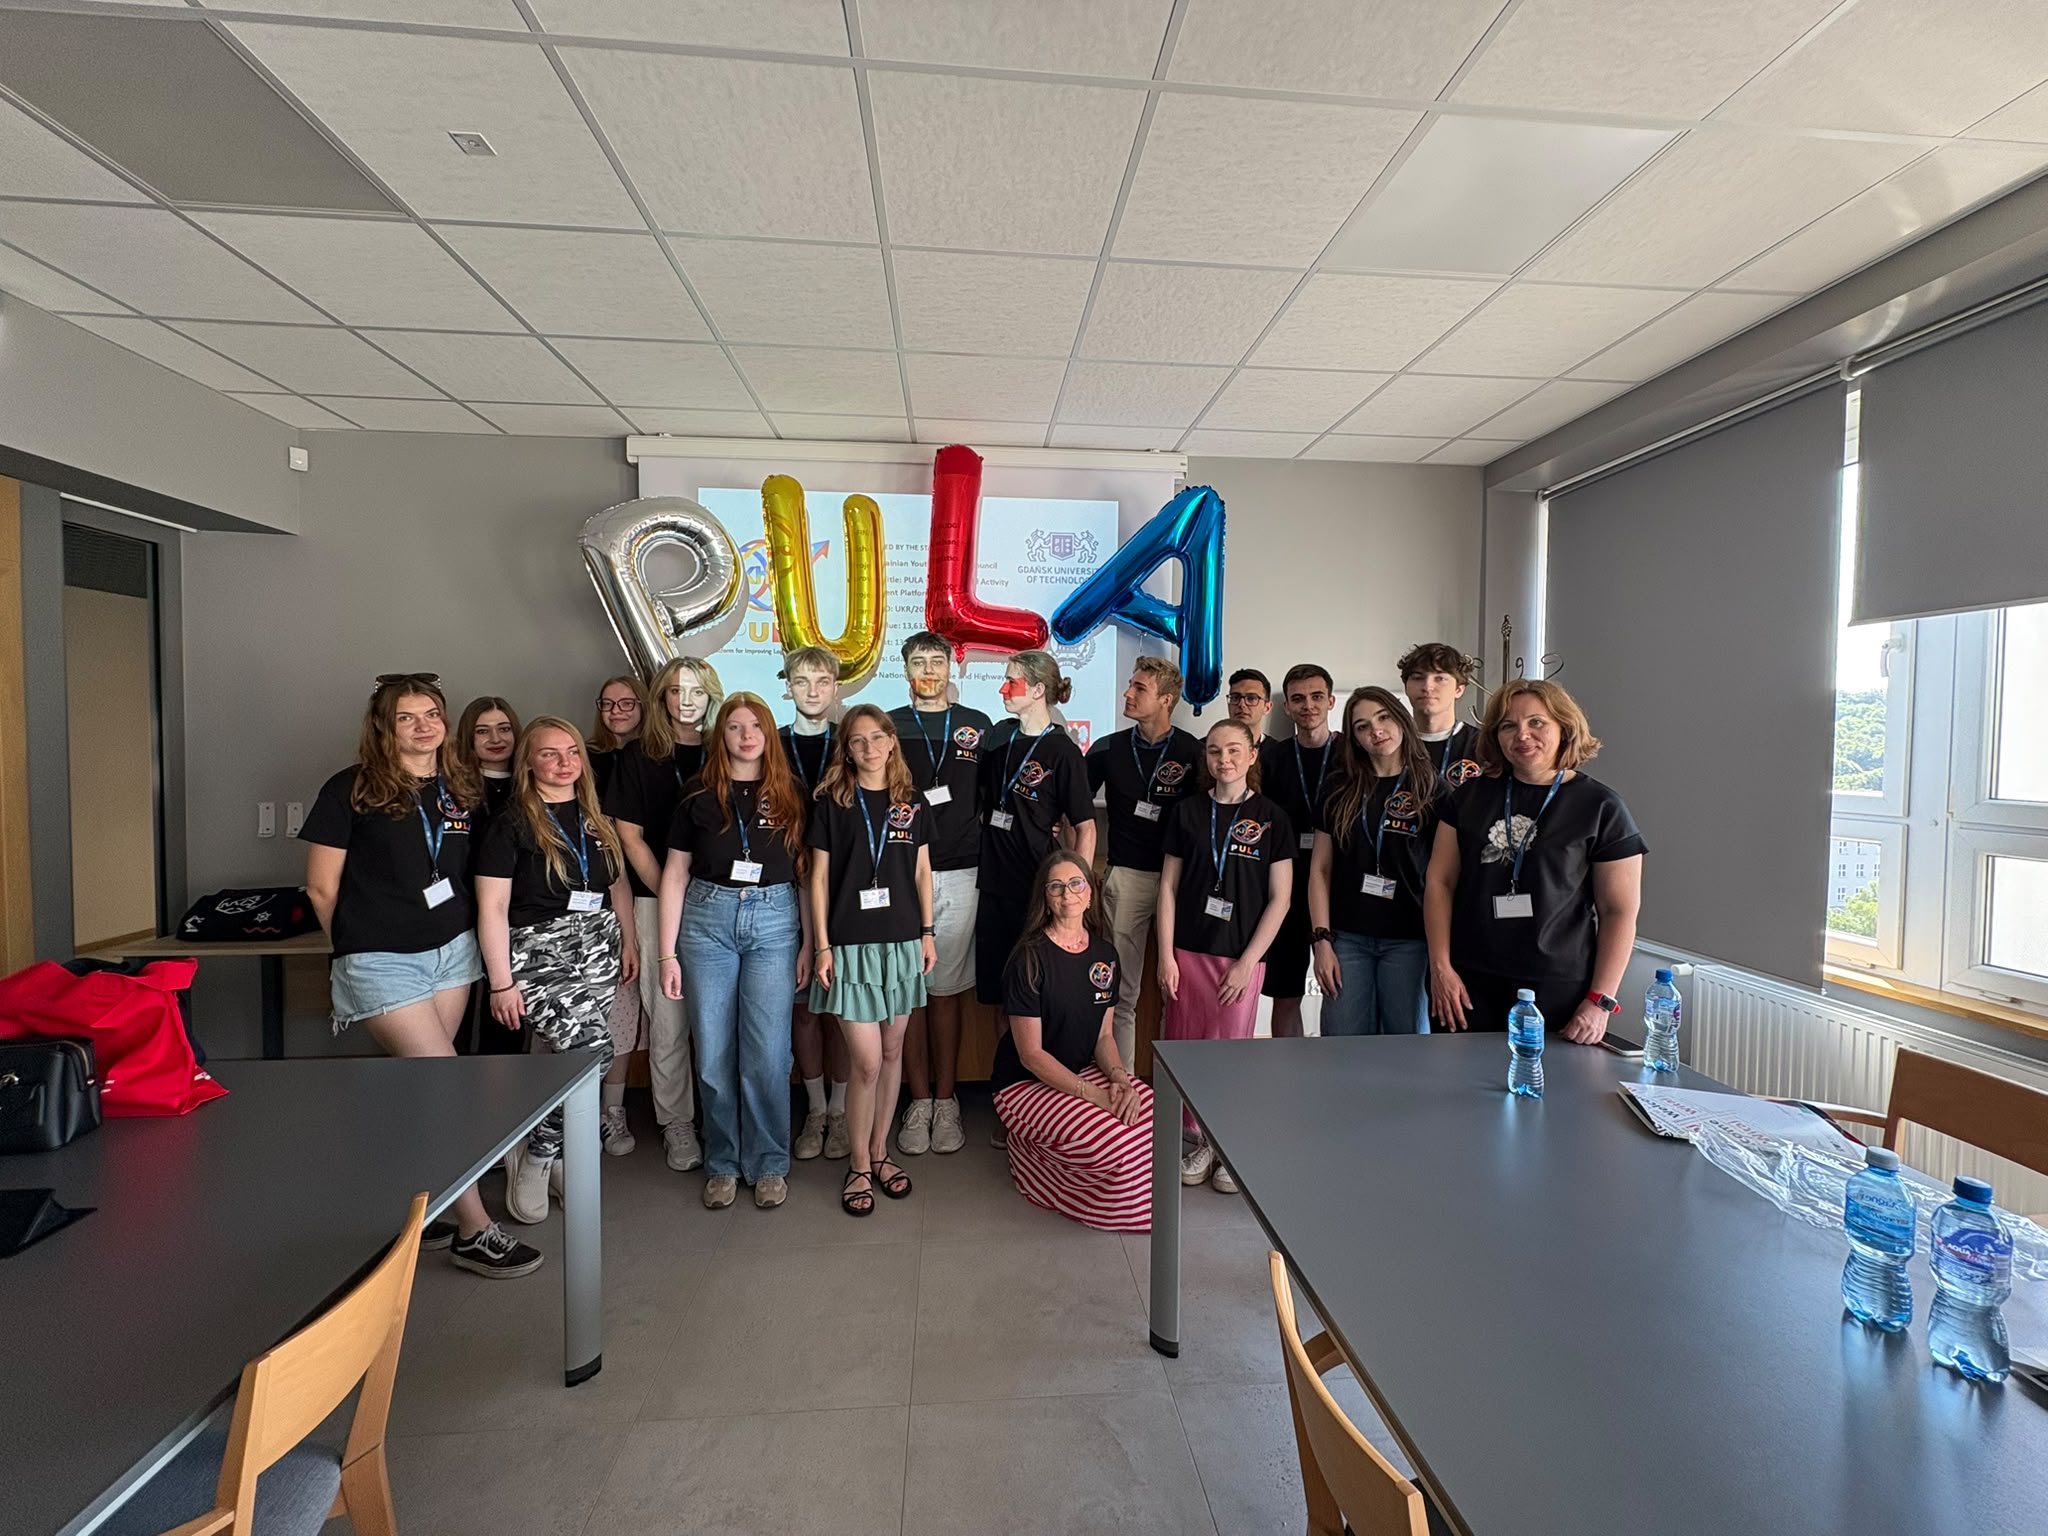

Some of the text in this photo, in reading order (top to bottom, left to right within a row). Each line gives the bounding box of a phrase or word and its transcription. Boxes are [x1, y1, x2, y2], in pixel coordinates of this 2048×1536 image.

[895, 543, 905, 551] BY
[911, 560, 927, 568] Yout
[903, 576, 924, 584] PULA
[980, 578, 1009, 587] Activity
[1026, 575, 1039, 584] OF
[900, 589, 925, 597] Platfor
[744, 648, 772, 656] Improving
[1014, 783, 1038, 798] PULA
[1383, 819, 1418, 832] PULA
[1230, 844, 1260, 856] PULA
